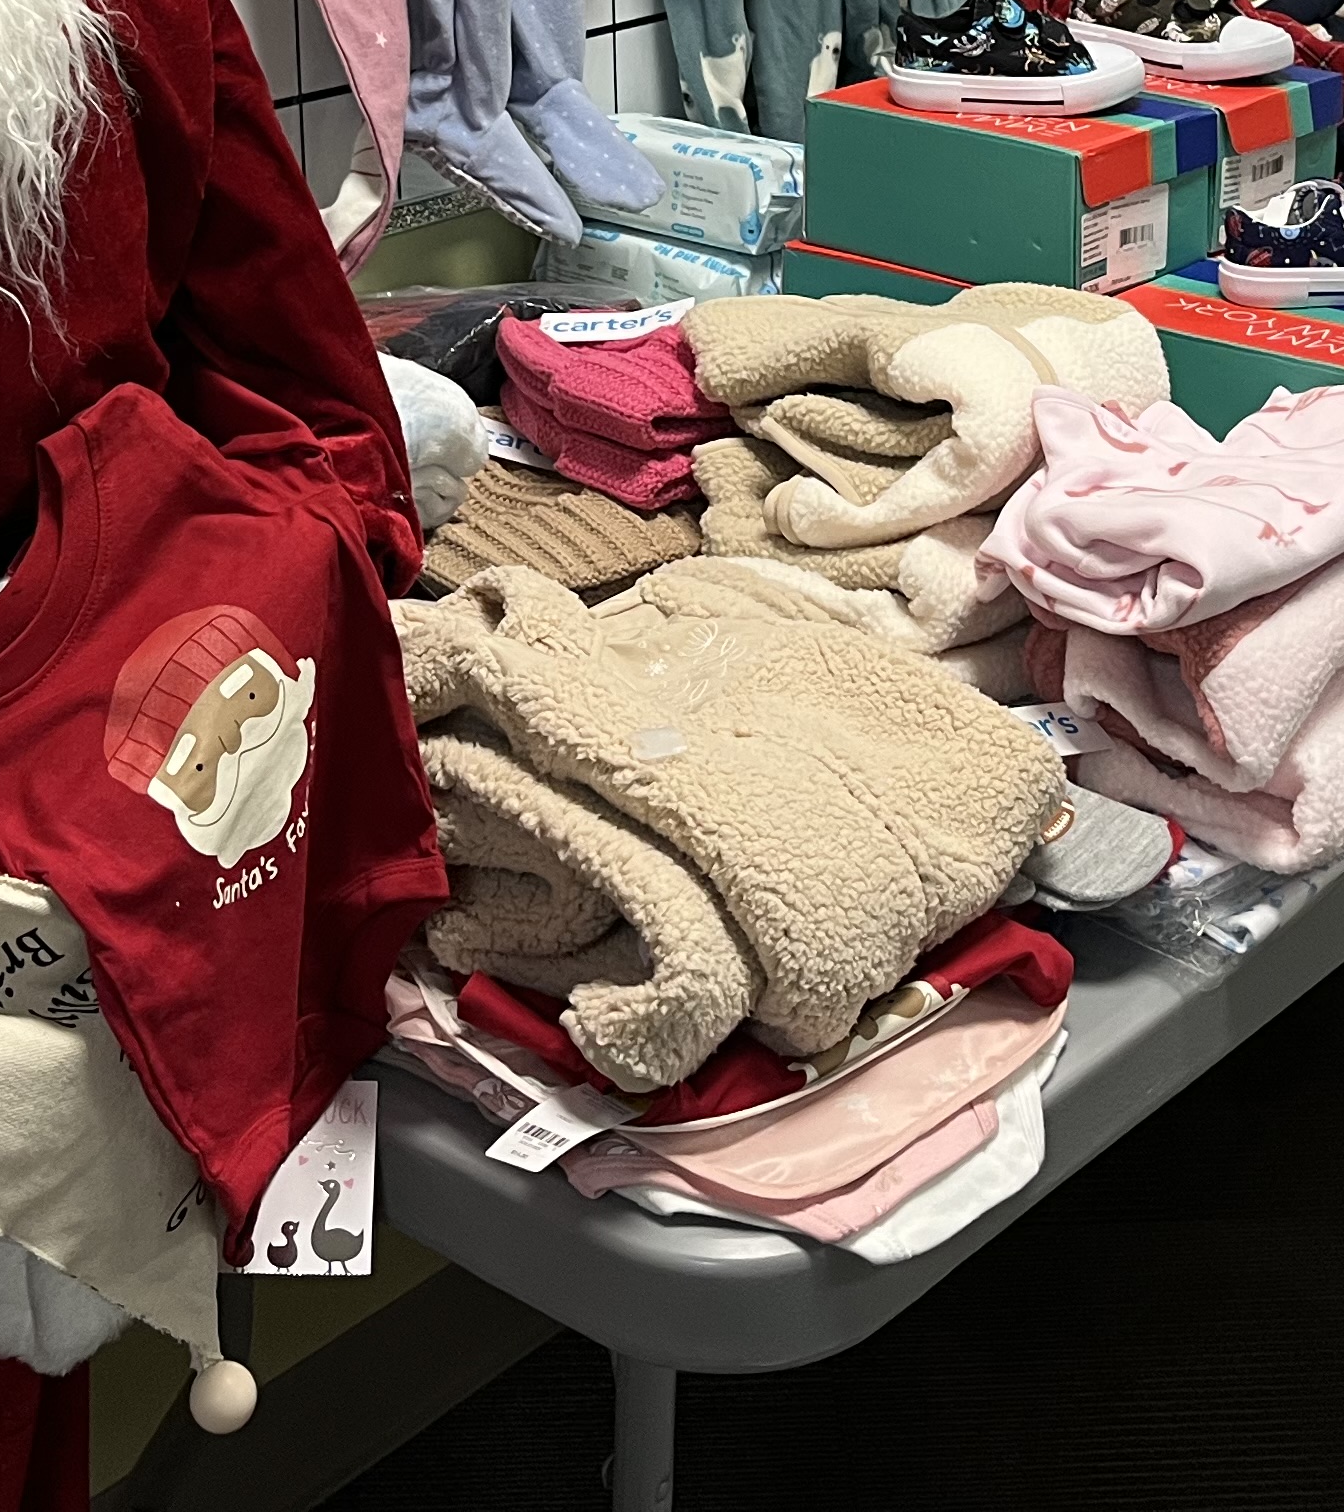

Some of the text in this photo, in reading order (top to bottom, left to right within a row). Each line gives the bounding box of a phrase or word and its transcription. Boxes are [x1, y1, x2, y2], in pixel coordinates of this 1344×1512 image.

[553, 309, 674, 333] carter's
[1166, 296, 1276, 332] YORK
[213, 855, 279, 910] Santa's
